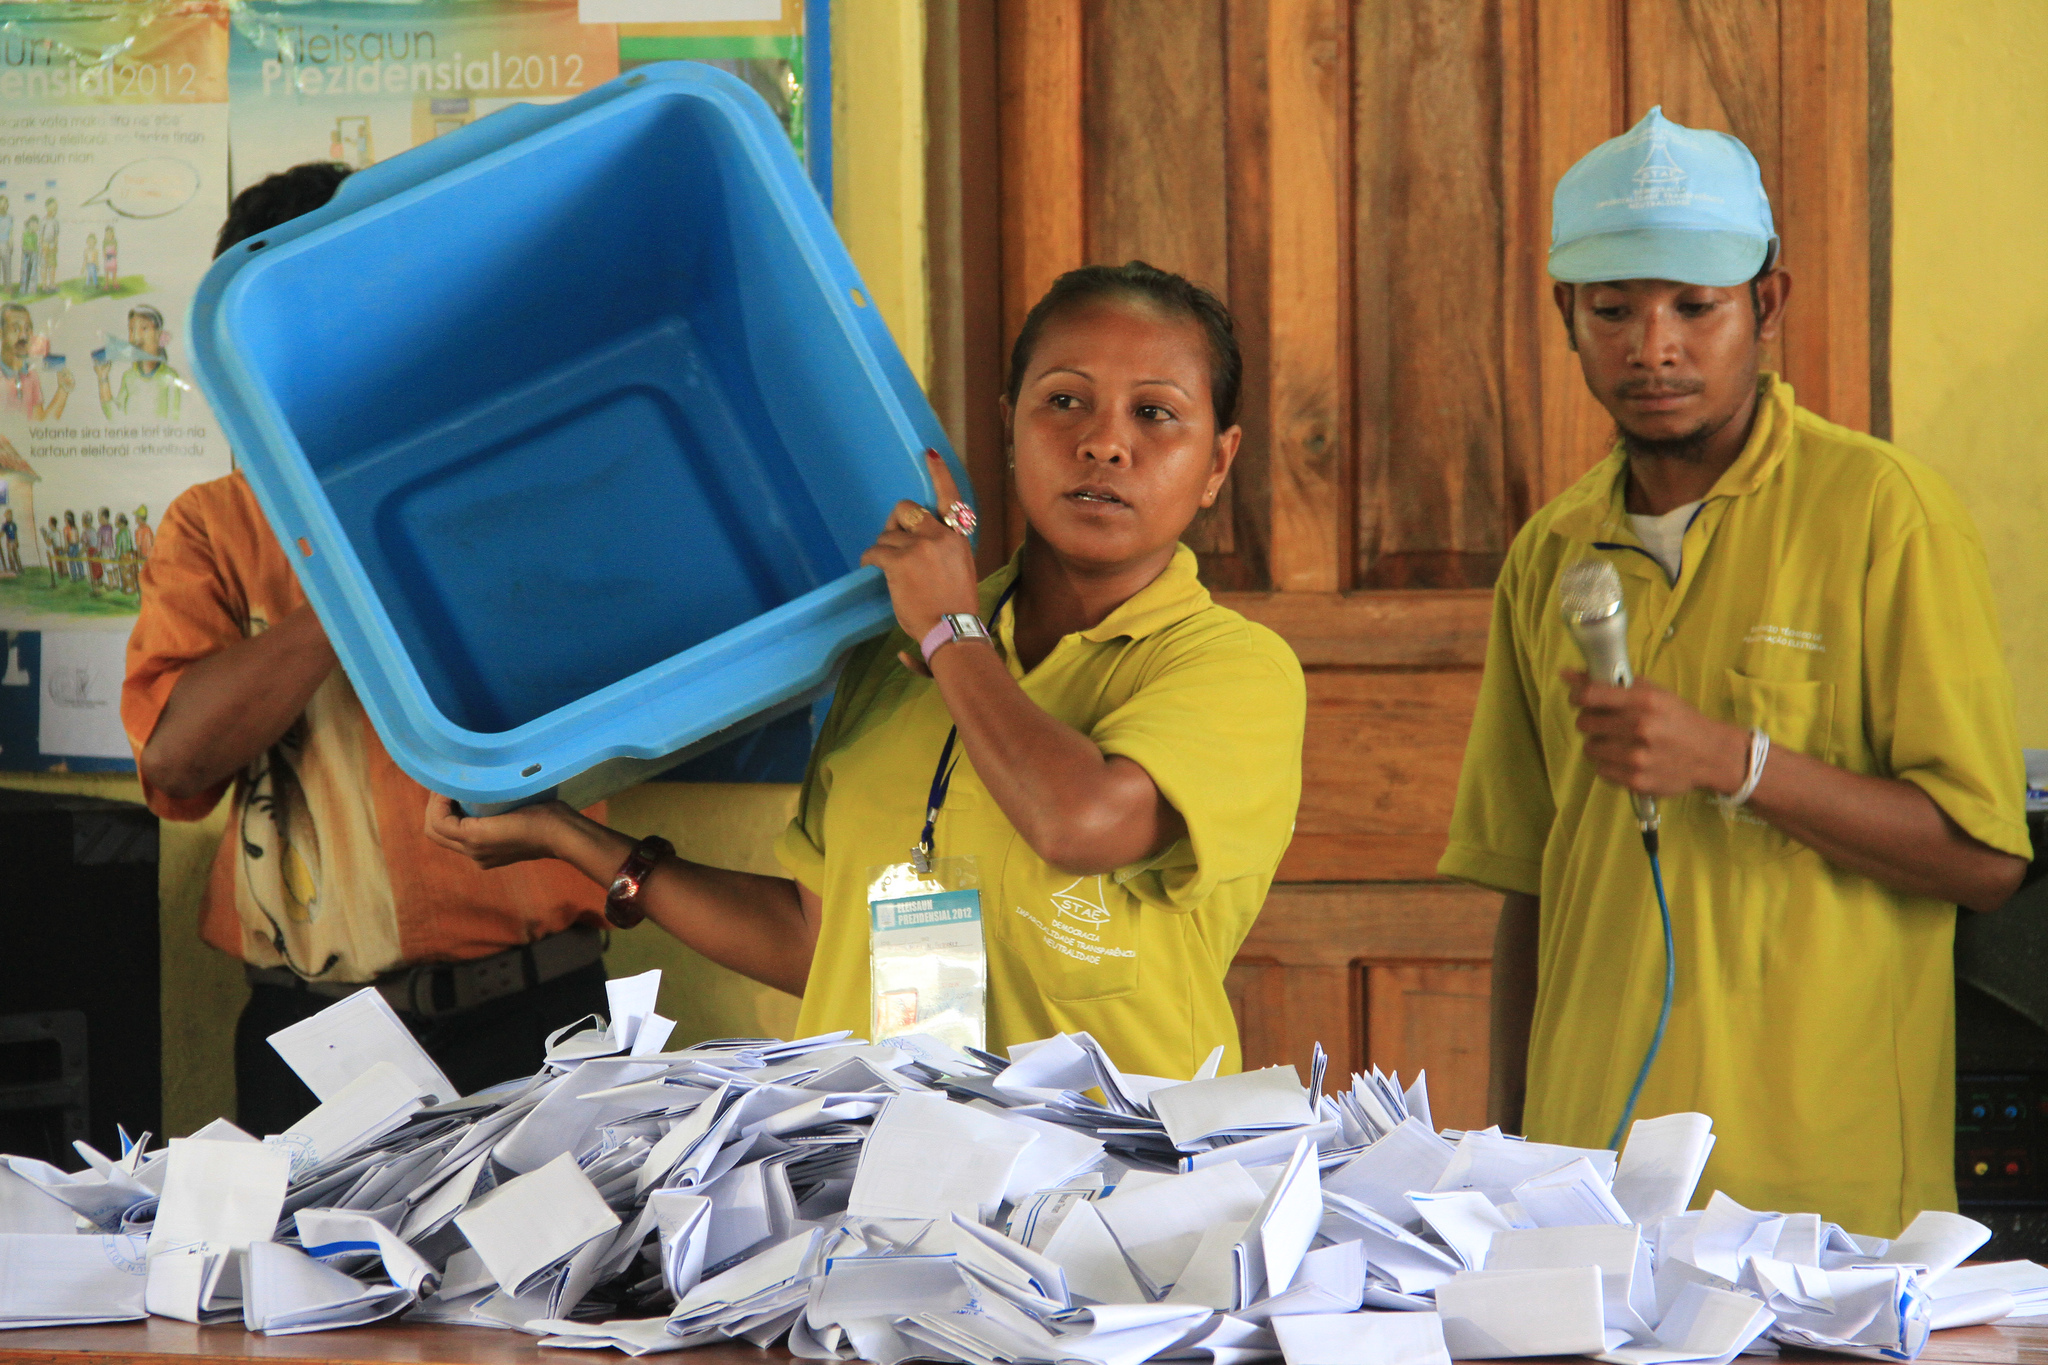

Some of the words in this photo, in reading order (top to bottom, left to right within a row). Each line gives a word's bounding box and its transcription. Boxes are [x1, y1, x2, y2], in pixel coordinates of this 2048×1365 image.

[29, 426, 77, 440] Votante
[898, 909, 952, 926] PREZIDENSIAL
[952, 907, 972, 920] 2012
[1060, 899, 1102, 921] STAE
[1051, 919, 1101, 942] DEMOCRACIA
[1043, 935, 1102, 965] NEUTRALIDADE
